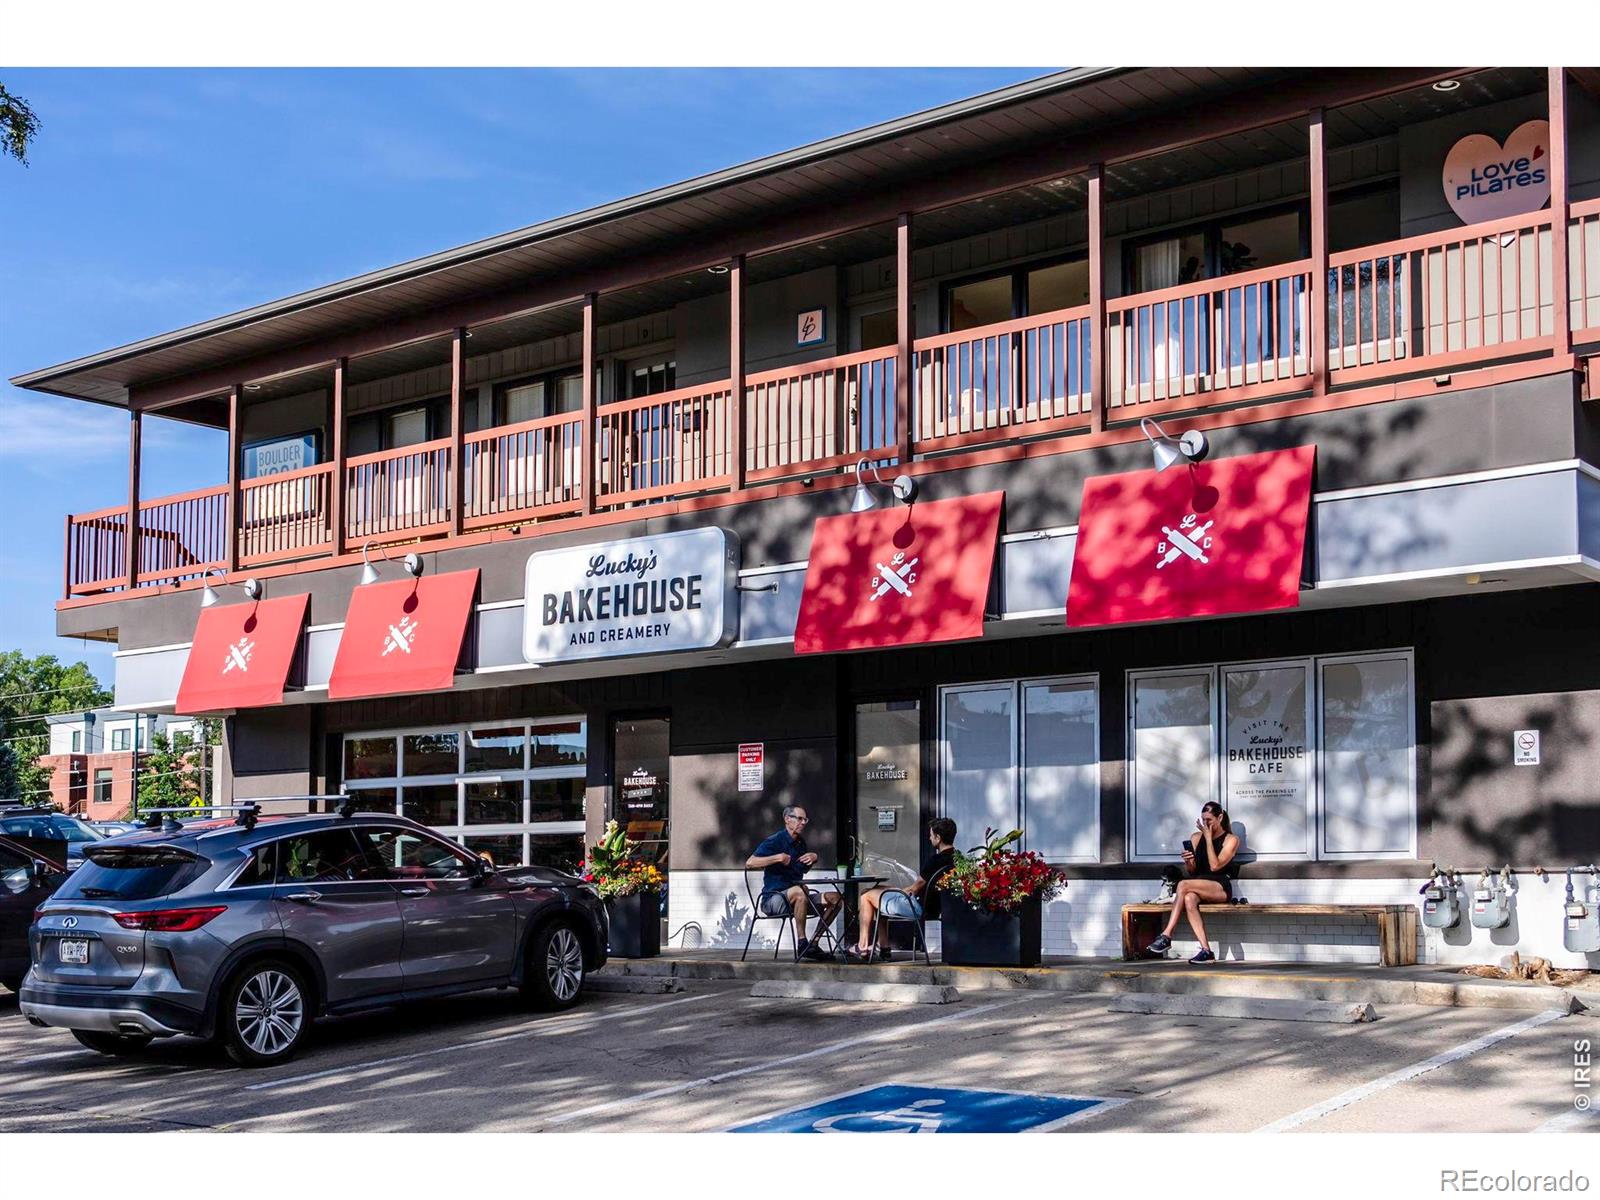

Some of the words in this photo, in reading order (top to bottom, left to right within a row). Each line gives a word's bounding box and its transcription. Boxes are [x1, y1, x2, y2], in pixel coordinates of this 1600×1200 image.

[259, 444, 301, 467] BOULDER
[586, 550, 657, 580] Lucky's
[543, 574, 702, 626] BAKEHOUSE
[570, 631, 595, 646] AND
[600, 623, 671, 642] CREAMERY
[1241, 720, 1268, 734] VISIT
[1273, 720, 1290, 732] THE
[1249, 735, 1283, 746] Lucky's
[1229, 746, 1303, 761] BAKEHOUSE
[866, 770, 906, 780] BAKEHOUSE
[1249, 762, 1283, 774] CAFE
[623, 776, 657, 786] BAKEHOUSE
[116, 945, 137, 954] QX50
